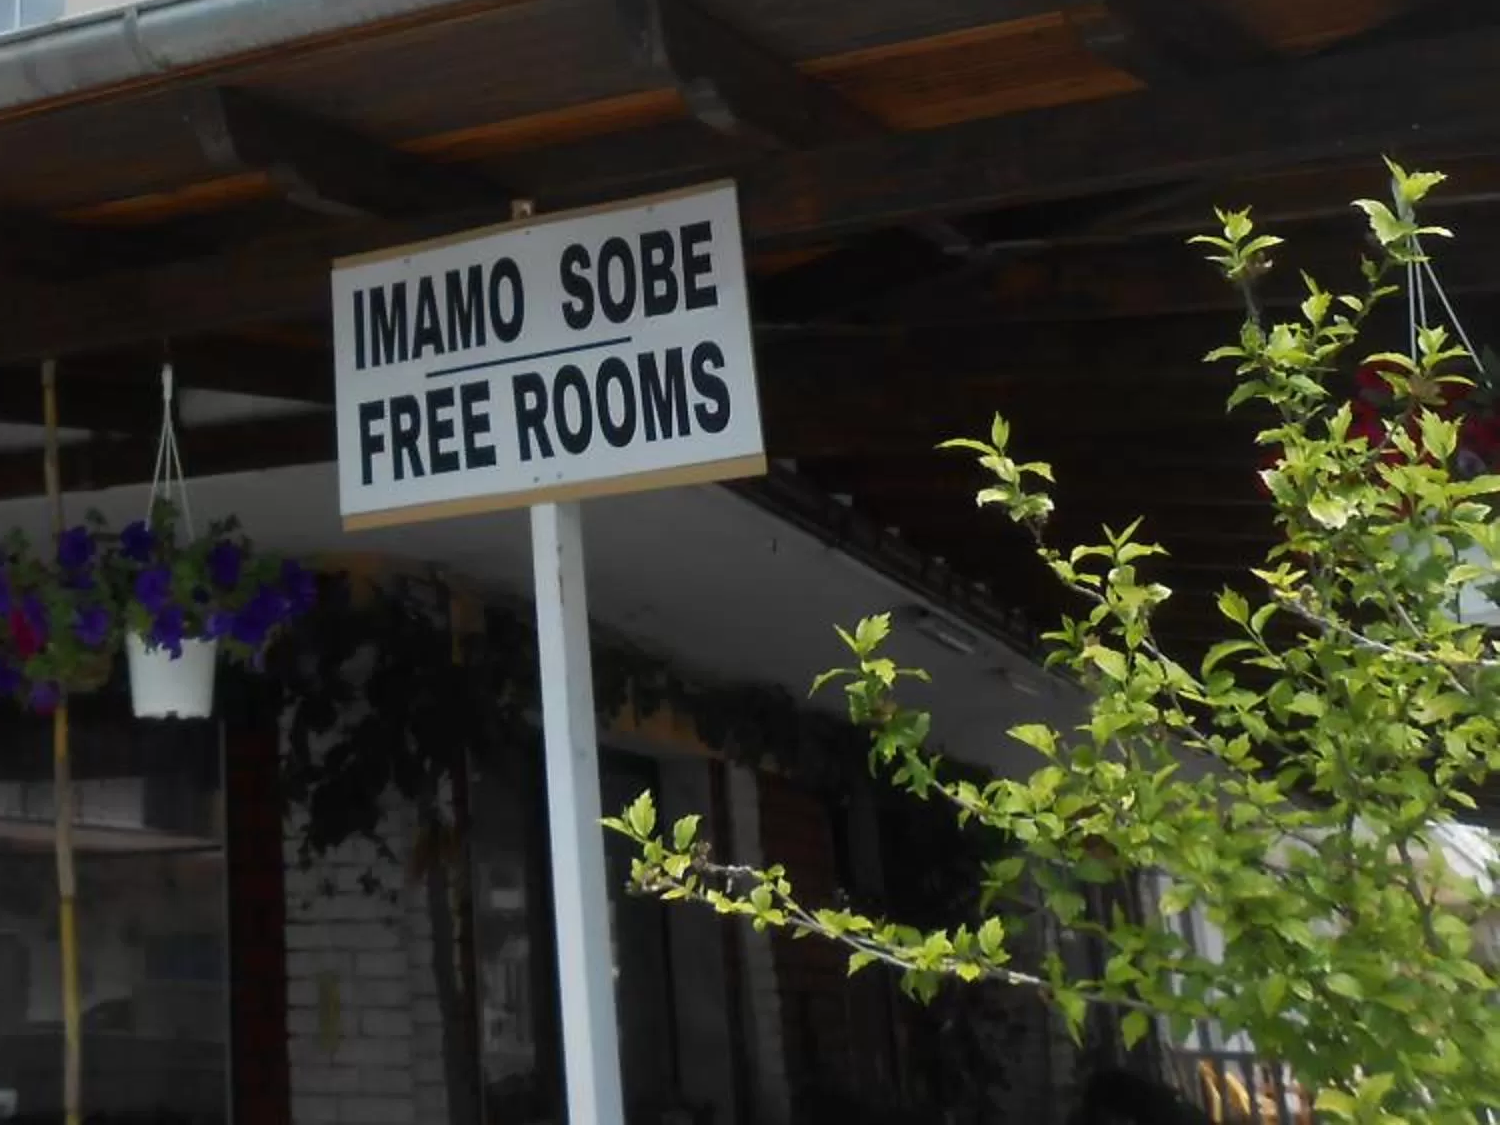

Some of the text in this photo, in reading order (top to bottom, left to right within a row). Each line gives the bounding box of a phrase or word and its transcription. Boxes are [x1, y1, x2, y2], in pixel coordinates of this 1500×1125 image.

[353, 220, 718, 371] IMAMO SOBE
[359, 341, 731, 485] FREE ROOMS
